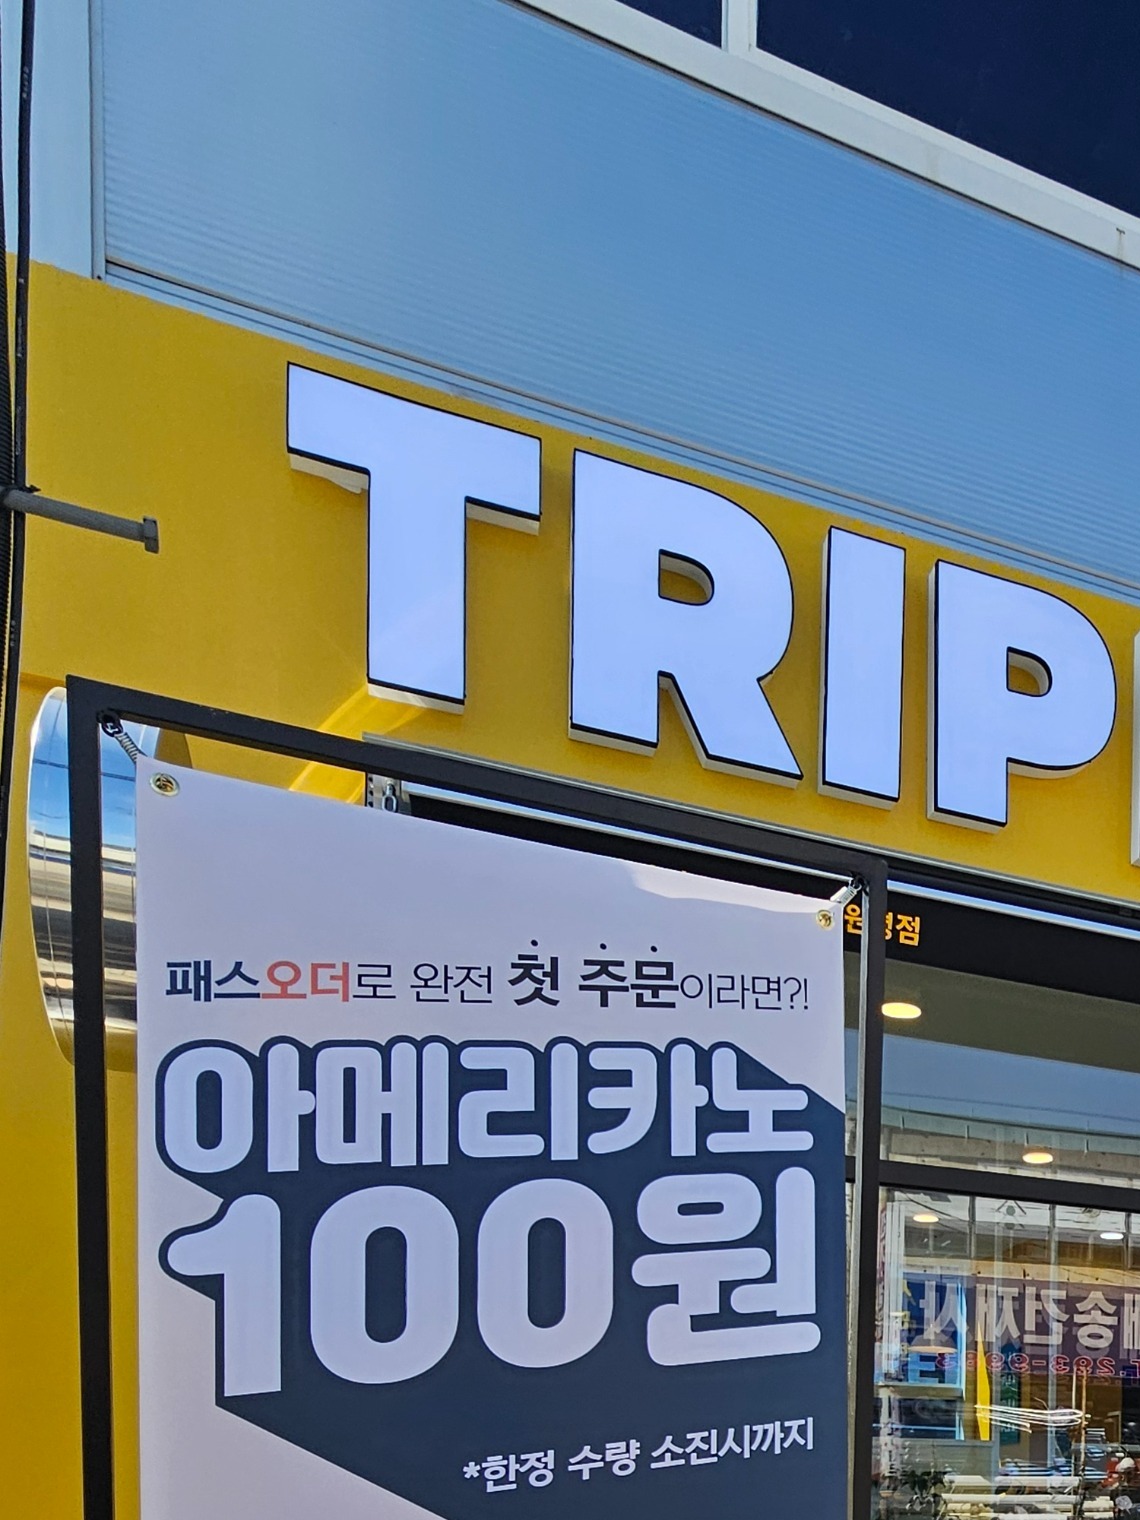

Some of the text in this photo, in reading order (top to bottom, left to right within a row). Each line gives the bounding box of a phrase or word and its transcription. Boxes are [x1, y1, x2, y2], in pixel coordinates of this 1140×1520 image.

[163, 954, 810, 1011] 패스오더로 완전 첫 주문이라면?!
[159, 1038, 815, 1175] 아메리카노
[163, 1165, 822, 1398] 100원
[567, 1437, 641, 1482] 수량
[650, 1417, 815, 1473] 소진시까지
